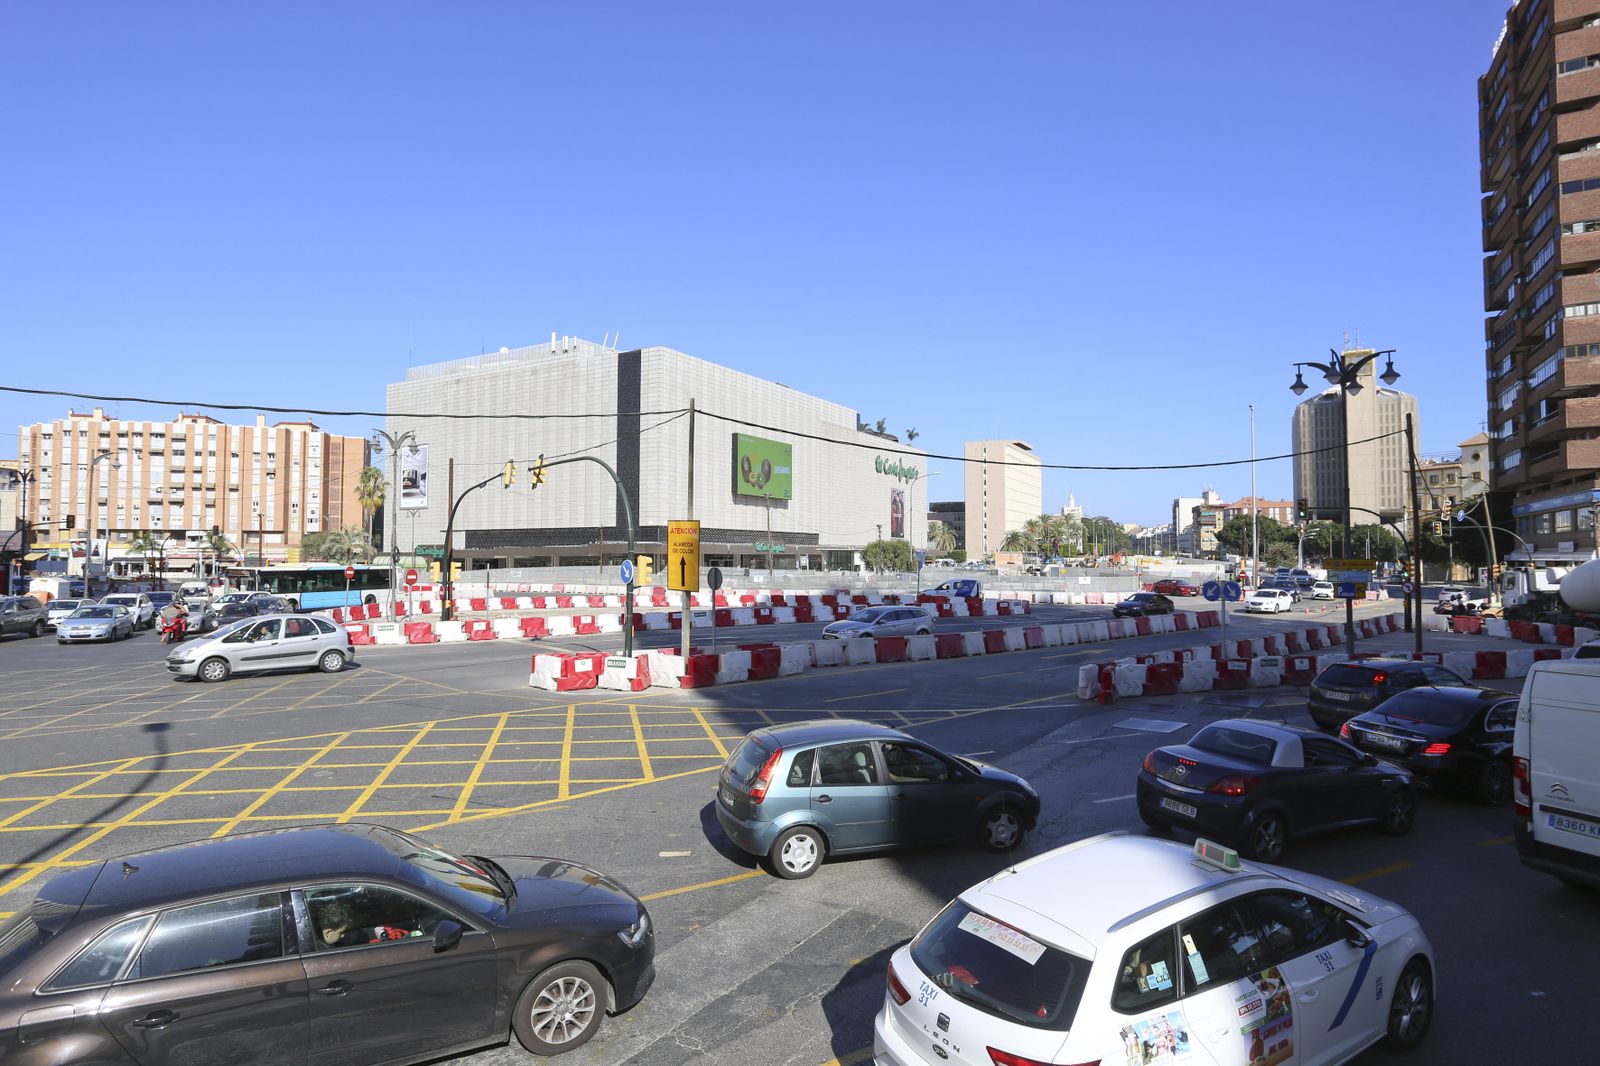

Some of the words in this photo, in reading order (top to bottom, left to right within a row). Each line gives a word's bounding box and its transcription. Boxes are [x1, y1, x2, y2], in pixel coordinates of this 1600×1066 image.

[1556, 817, 1586, 832] 8360
[1315, 949, 1333, 965] TAXI
[1323, 961, 1335, 973] 31
[919, 980, 939, 1001] TAXI
[918, 992, 929, 1008] 31
[923, 1024, 960, 1054] LEON
